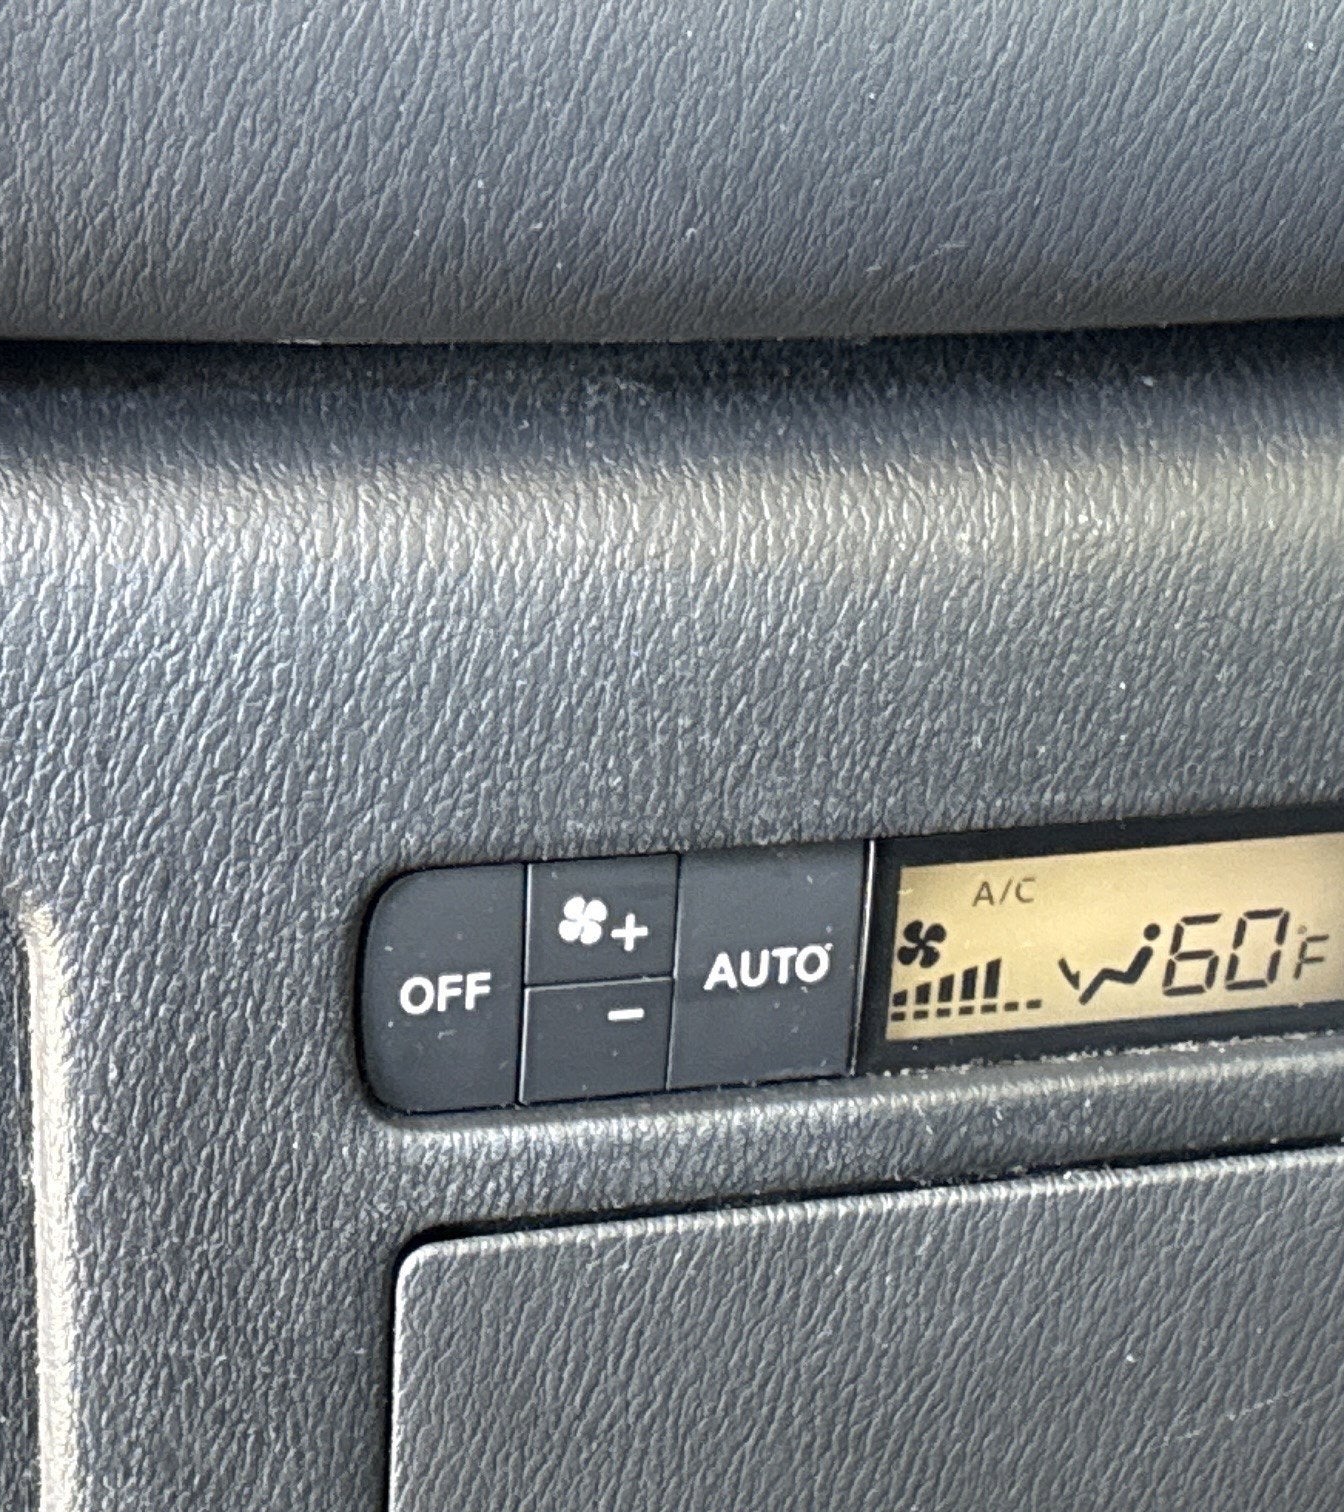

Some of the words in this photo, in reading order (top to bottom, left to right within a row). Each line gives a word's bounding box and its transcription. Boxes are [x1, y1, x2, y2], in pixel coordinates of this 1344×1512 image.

[972, 877, 1037, 907] A/C
[702, 942, 830, 991] AUTO
[399, 970, 492, 1015] OFF
